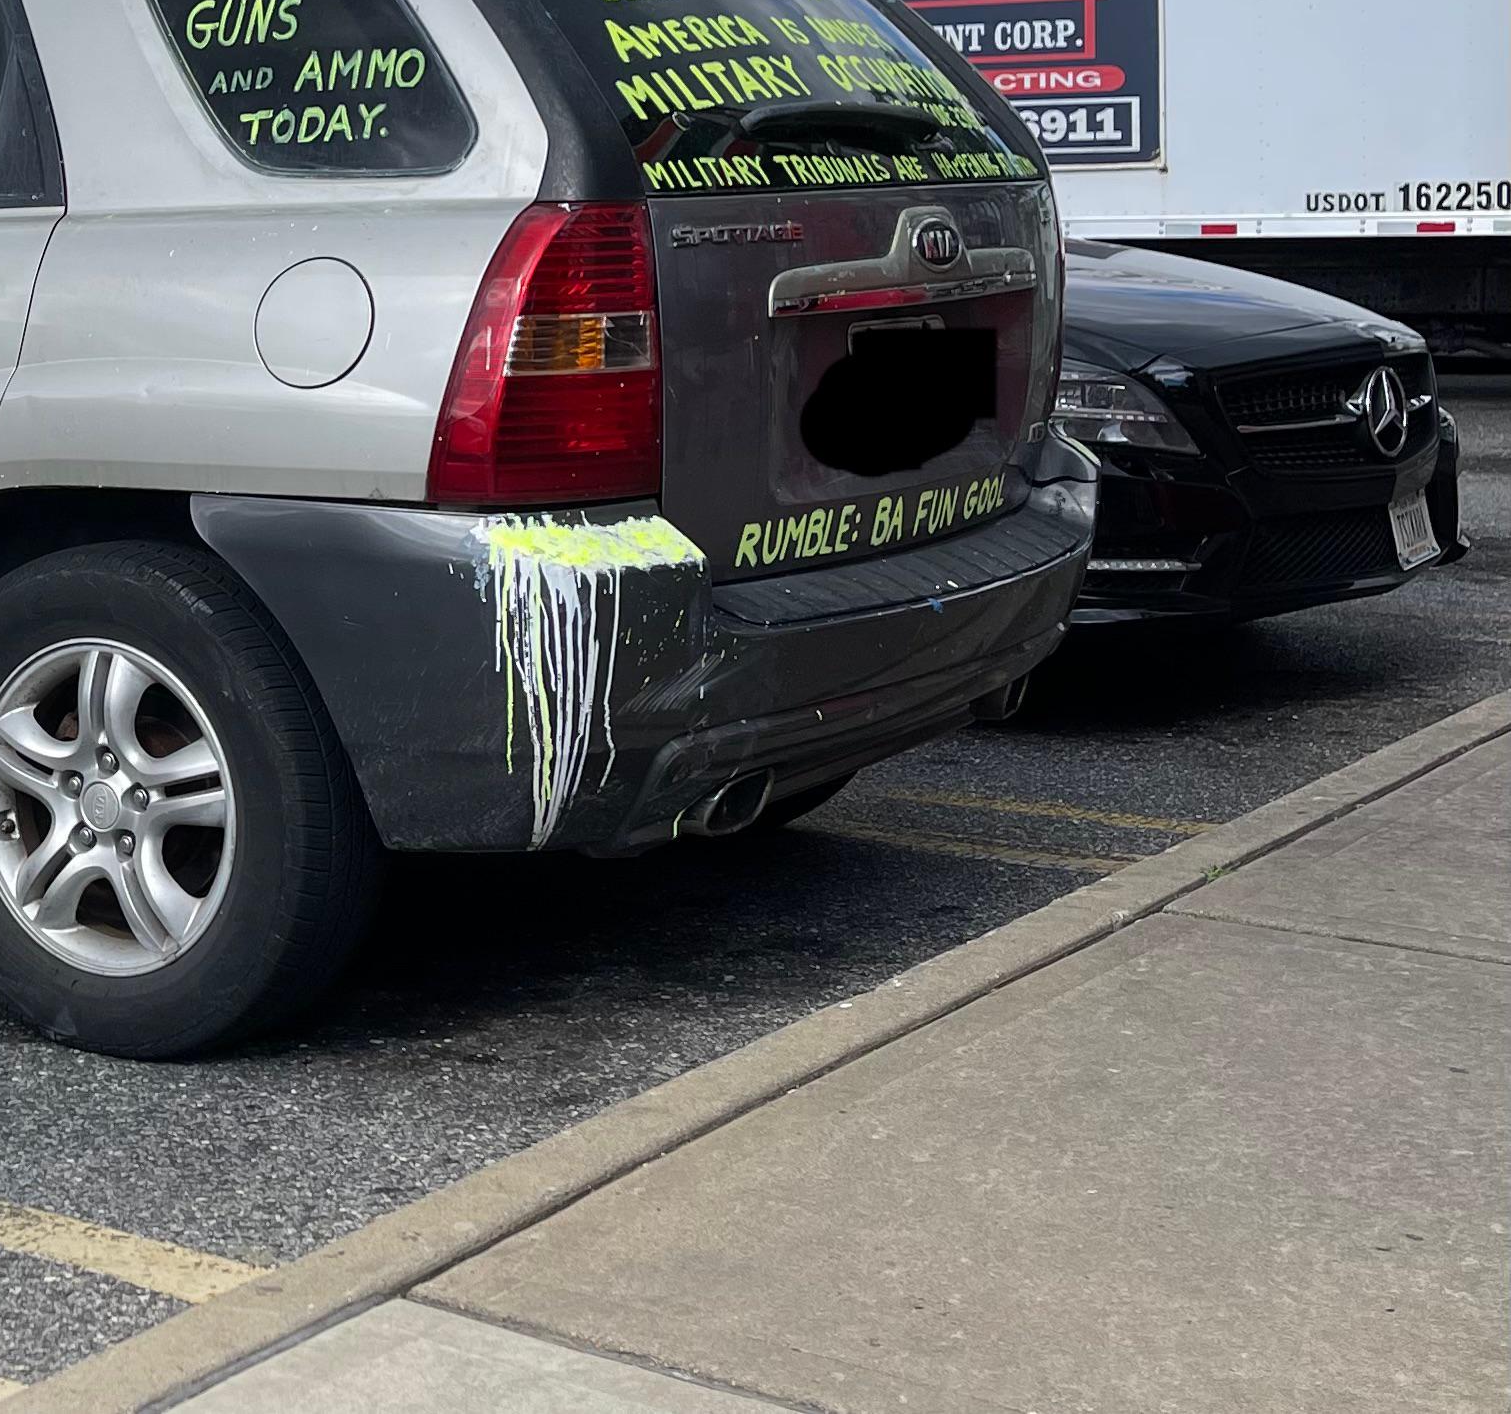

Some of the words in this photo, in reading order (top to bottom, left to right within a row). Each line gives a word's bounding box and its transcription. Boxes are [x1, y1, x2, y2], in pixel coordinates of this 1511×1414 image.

[604, 15, 770, 63] AMERICA
[769, 16, 810, 45] IS
[803, 16, 894, 53] UNDER
[994, 18, 1084, 51] CORP.
[208, 67, 274, 94] AND
[293, 48, 426, 92] AMMO
[615, 54, 811, 121] MILITARY
[993, 70, 1102, 91] CTING
[240, 103, 388, 145] TODAY.
[642, 154, 770, 190] MILITARY
[773, 154, 890, 186] TRIBUNALS
[891, 154, 928, 181] ARE
[1306, 192, 1385, 212] USDOT
[735, 504, 861, 568] RUMBLE:
[870, 496, 904, 546] BA
[913, 486, 960, 536] FUN
